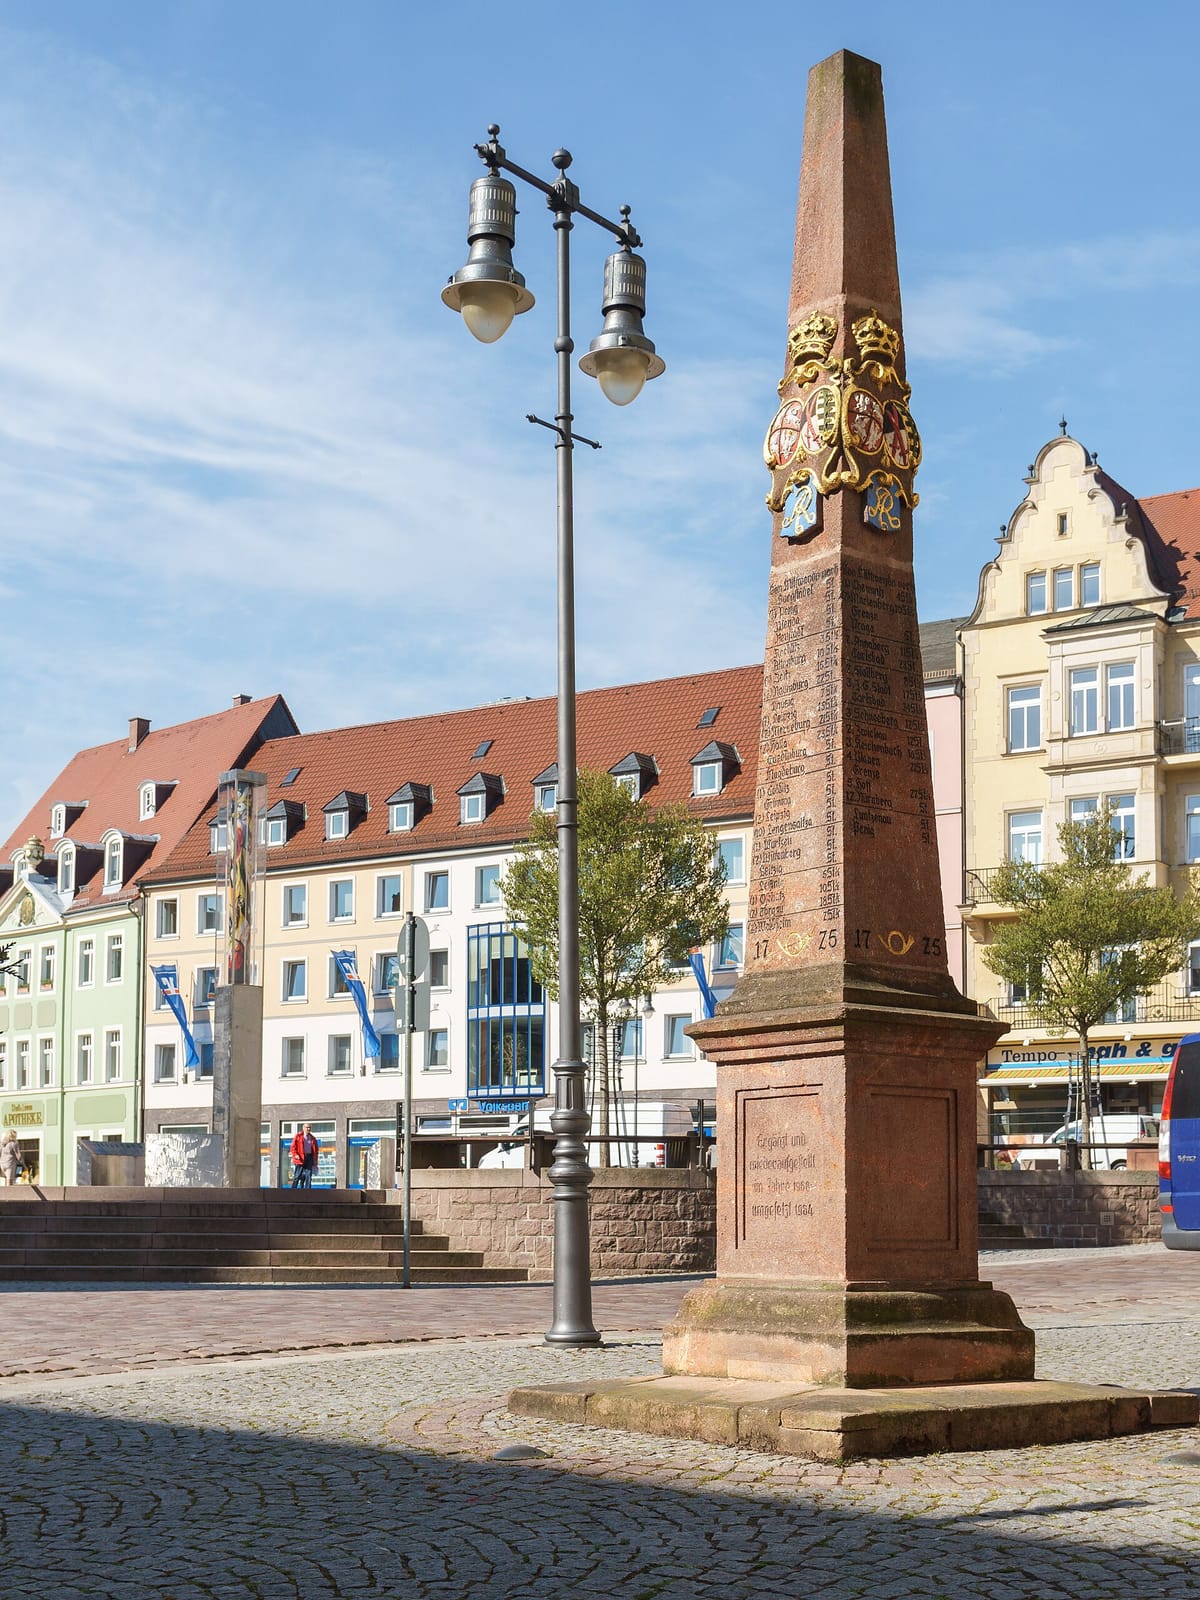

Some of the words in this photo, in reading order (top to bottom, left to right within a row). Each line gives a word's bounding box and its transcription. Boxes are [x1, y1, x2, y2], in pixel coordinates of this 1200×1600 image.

[854, 928, 871, 949] 17
[754, 940, 769, 960] 17
[1002, 1050, 1058, 1064] Tempo
[1136, 1042, 1152, 1057] &
[4, 1112, 43, 1126] APOTHEKE
[767, 1178, 790, 1194] Jahre
